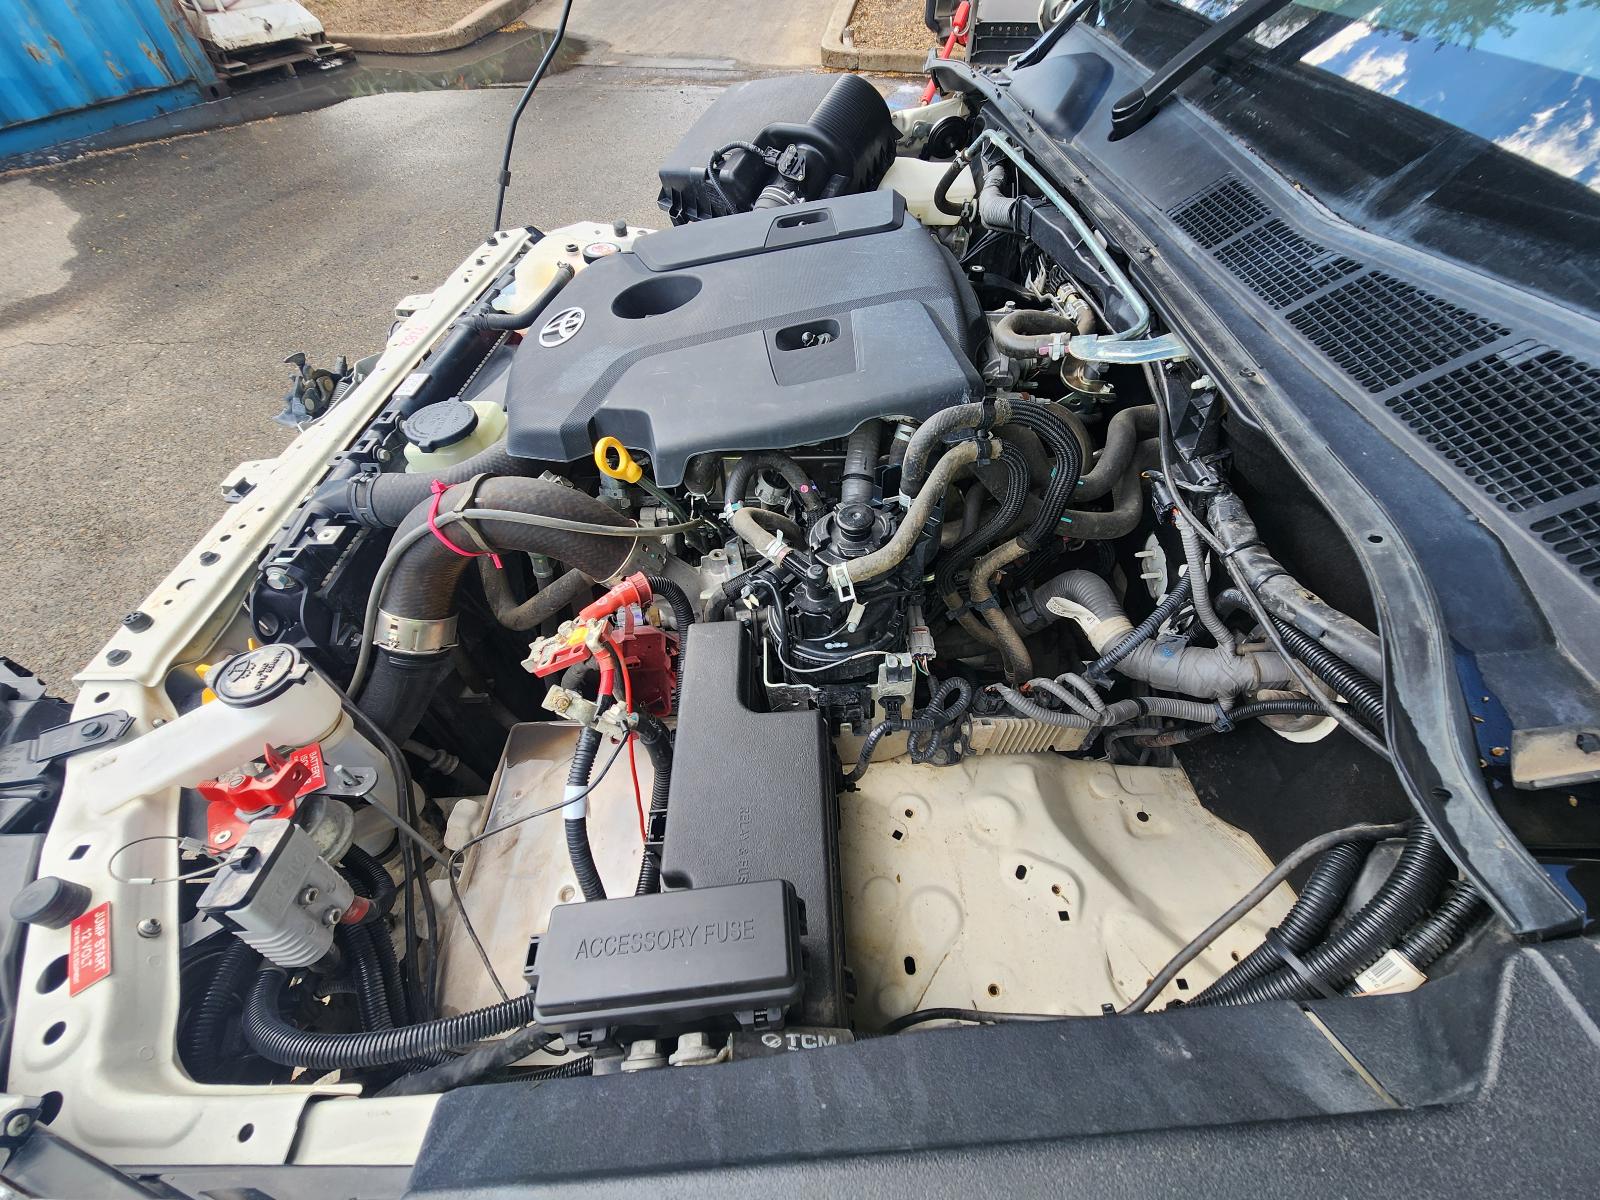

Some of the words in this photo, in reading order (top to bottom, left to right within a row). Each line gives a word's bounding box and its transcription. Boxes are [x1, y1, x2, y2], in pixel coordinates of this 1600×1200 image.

[310, 751, 320, 778] BATTERY
[739, 807, 750, 843] RELAY
[738, 860, 749, 884] FUS
[81, 927, 93, 942] 12
[94, 911, 106, 937] JUMP
[575, 924, 701, 961] ACCESSORY
[703, 918, 756, 946] FUSE
[81, 940, 93, 969] VOLT
[94, 938, 106, 973] START
[785, 1032, 837, 1050] TCM
